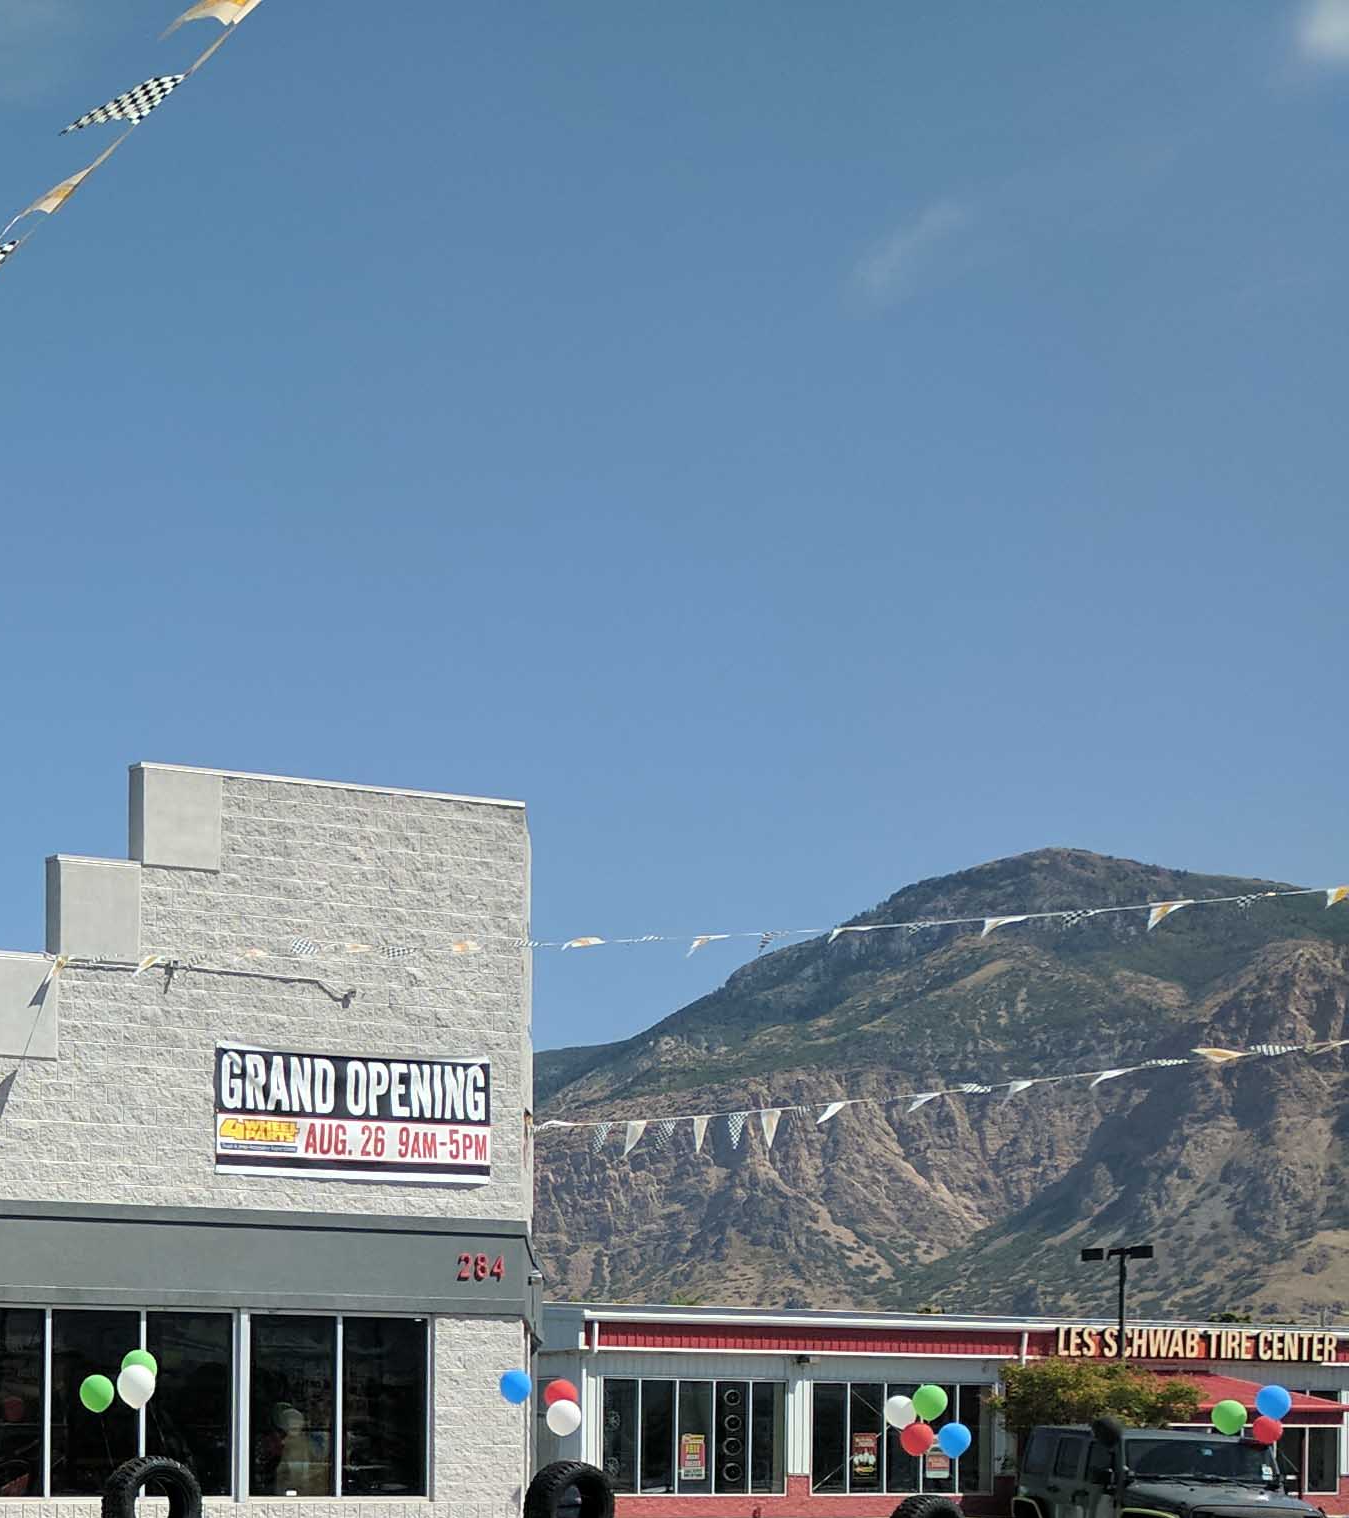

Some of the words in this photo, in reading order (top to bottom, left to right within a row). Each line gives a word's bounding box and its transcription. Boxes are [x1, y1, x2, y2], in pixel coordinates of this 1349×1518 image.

[220, 1051, 336, 1114] GRAND
[345, 1060, 487, 1122] OPENING
[304, 1122, 353, 1156] AUG.
[360, 1124, 385, 1158] 26
[397, 1126, 488, 1162] 9AM-5PM
[457, 1252, 505, 1282] 284
[1057, 1326, 1097, 1358] LES
[1208, 1329, 1254, 1360] TIRE
[1258, 1330, 1338, 1362] CENTER
